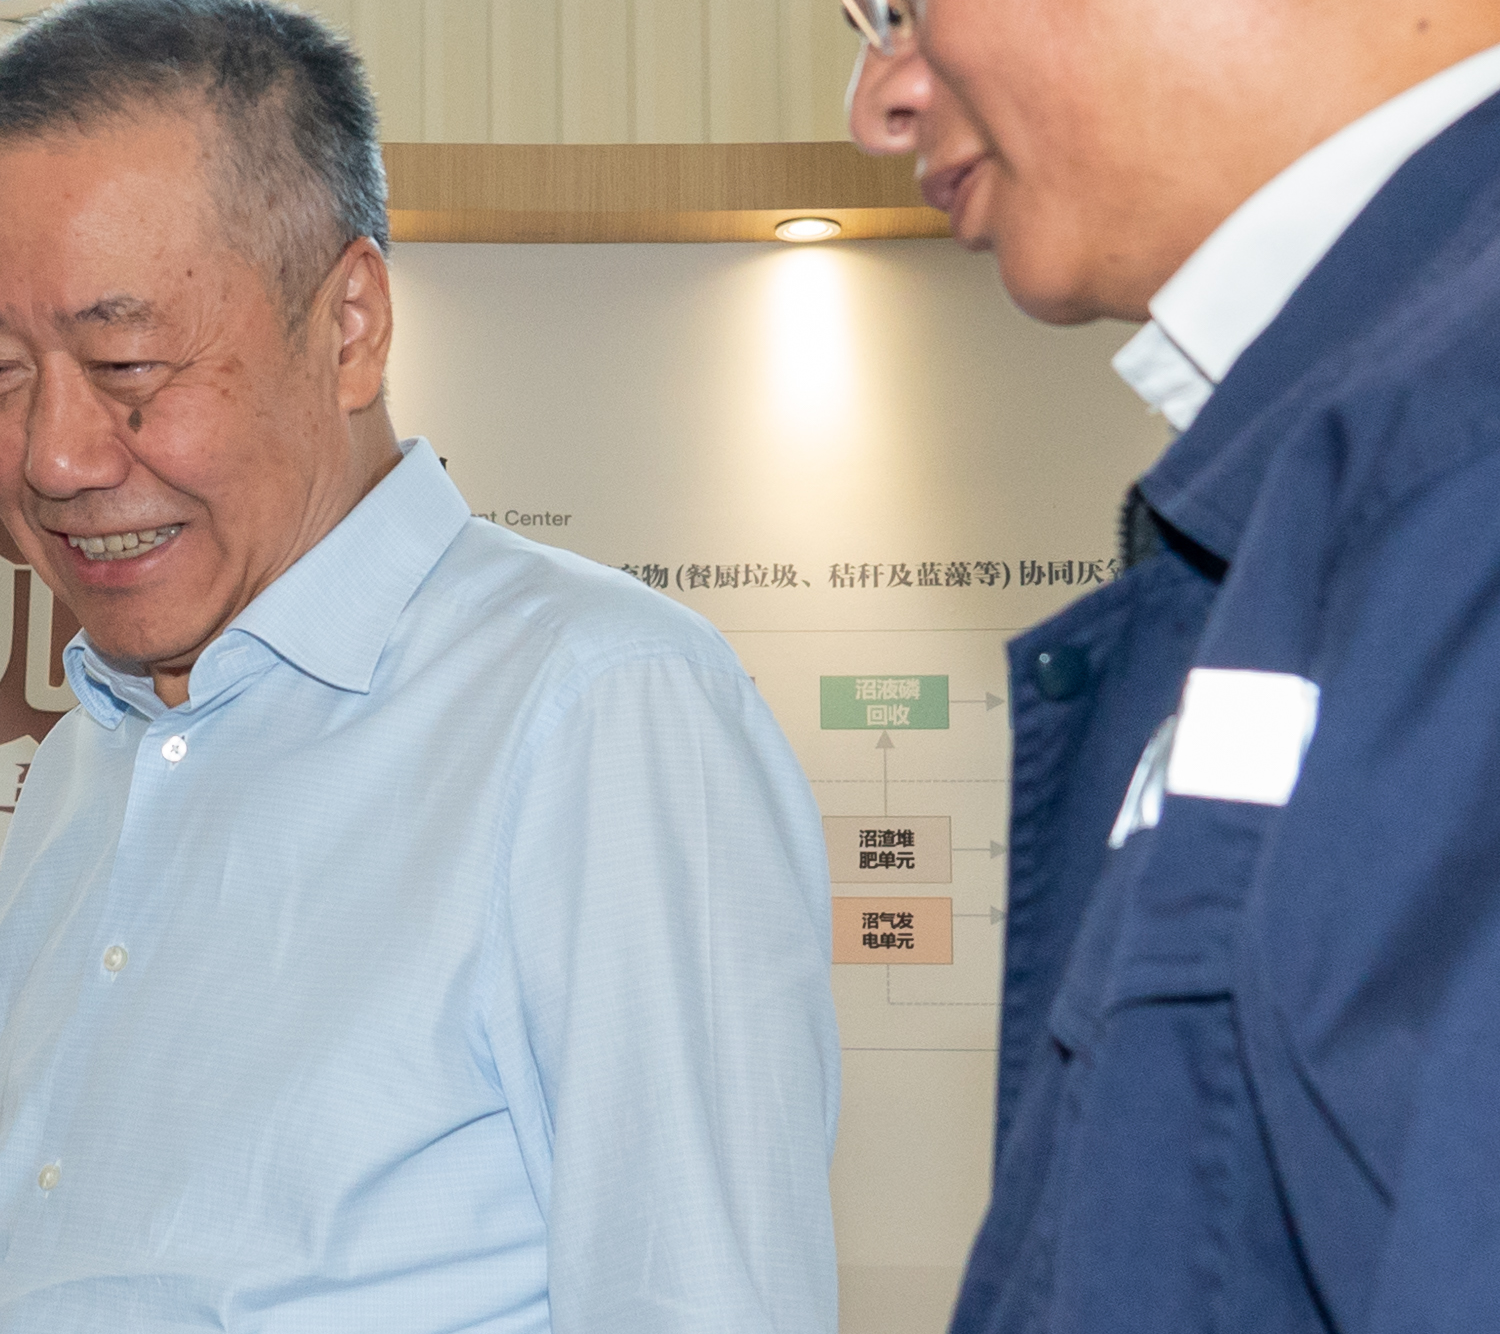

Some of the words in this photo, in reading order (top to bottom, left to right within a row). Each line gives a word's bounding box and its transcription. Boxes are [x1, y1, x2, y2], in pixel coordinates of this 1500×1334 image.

[504, 509, 573, 527] Center
[855, 678, 921, 701] 沼液磷
[866, 704, 911, 727] 回收
[858, 829, 915, 849] 沼渣堆
[858, 851, 915, 871] 肥单元
[862, 912, 914, 930] 沼气发
[862, 932, 914, 951] 电单元
